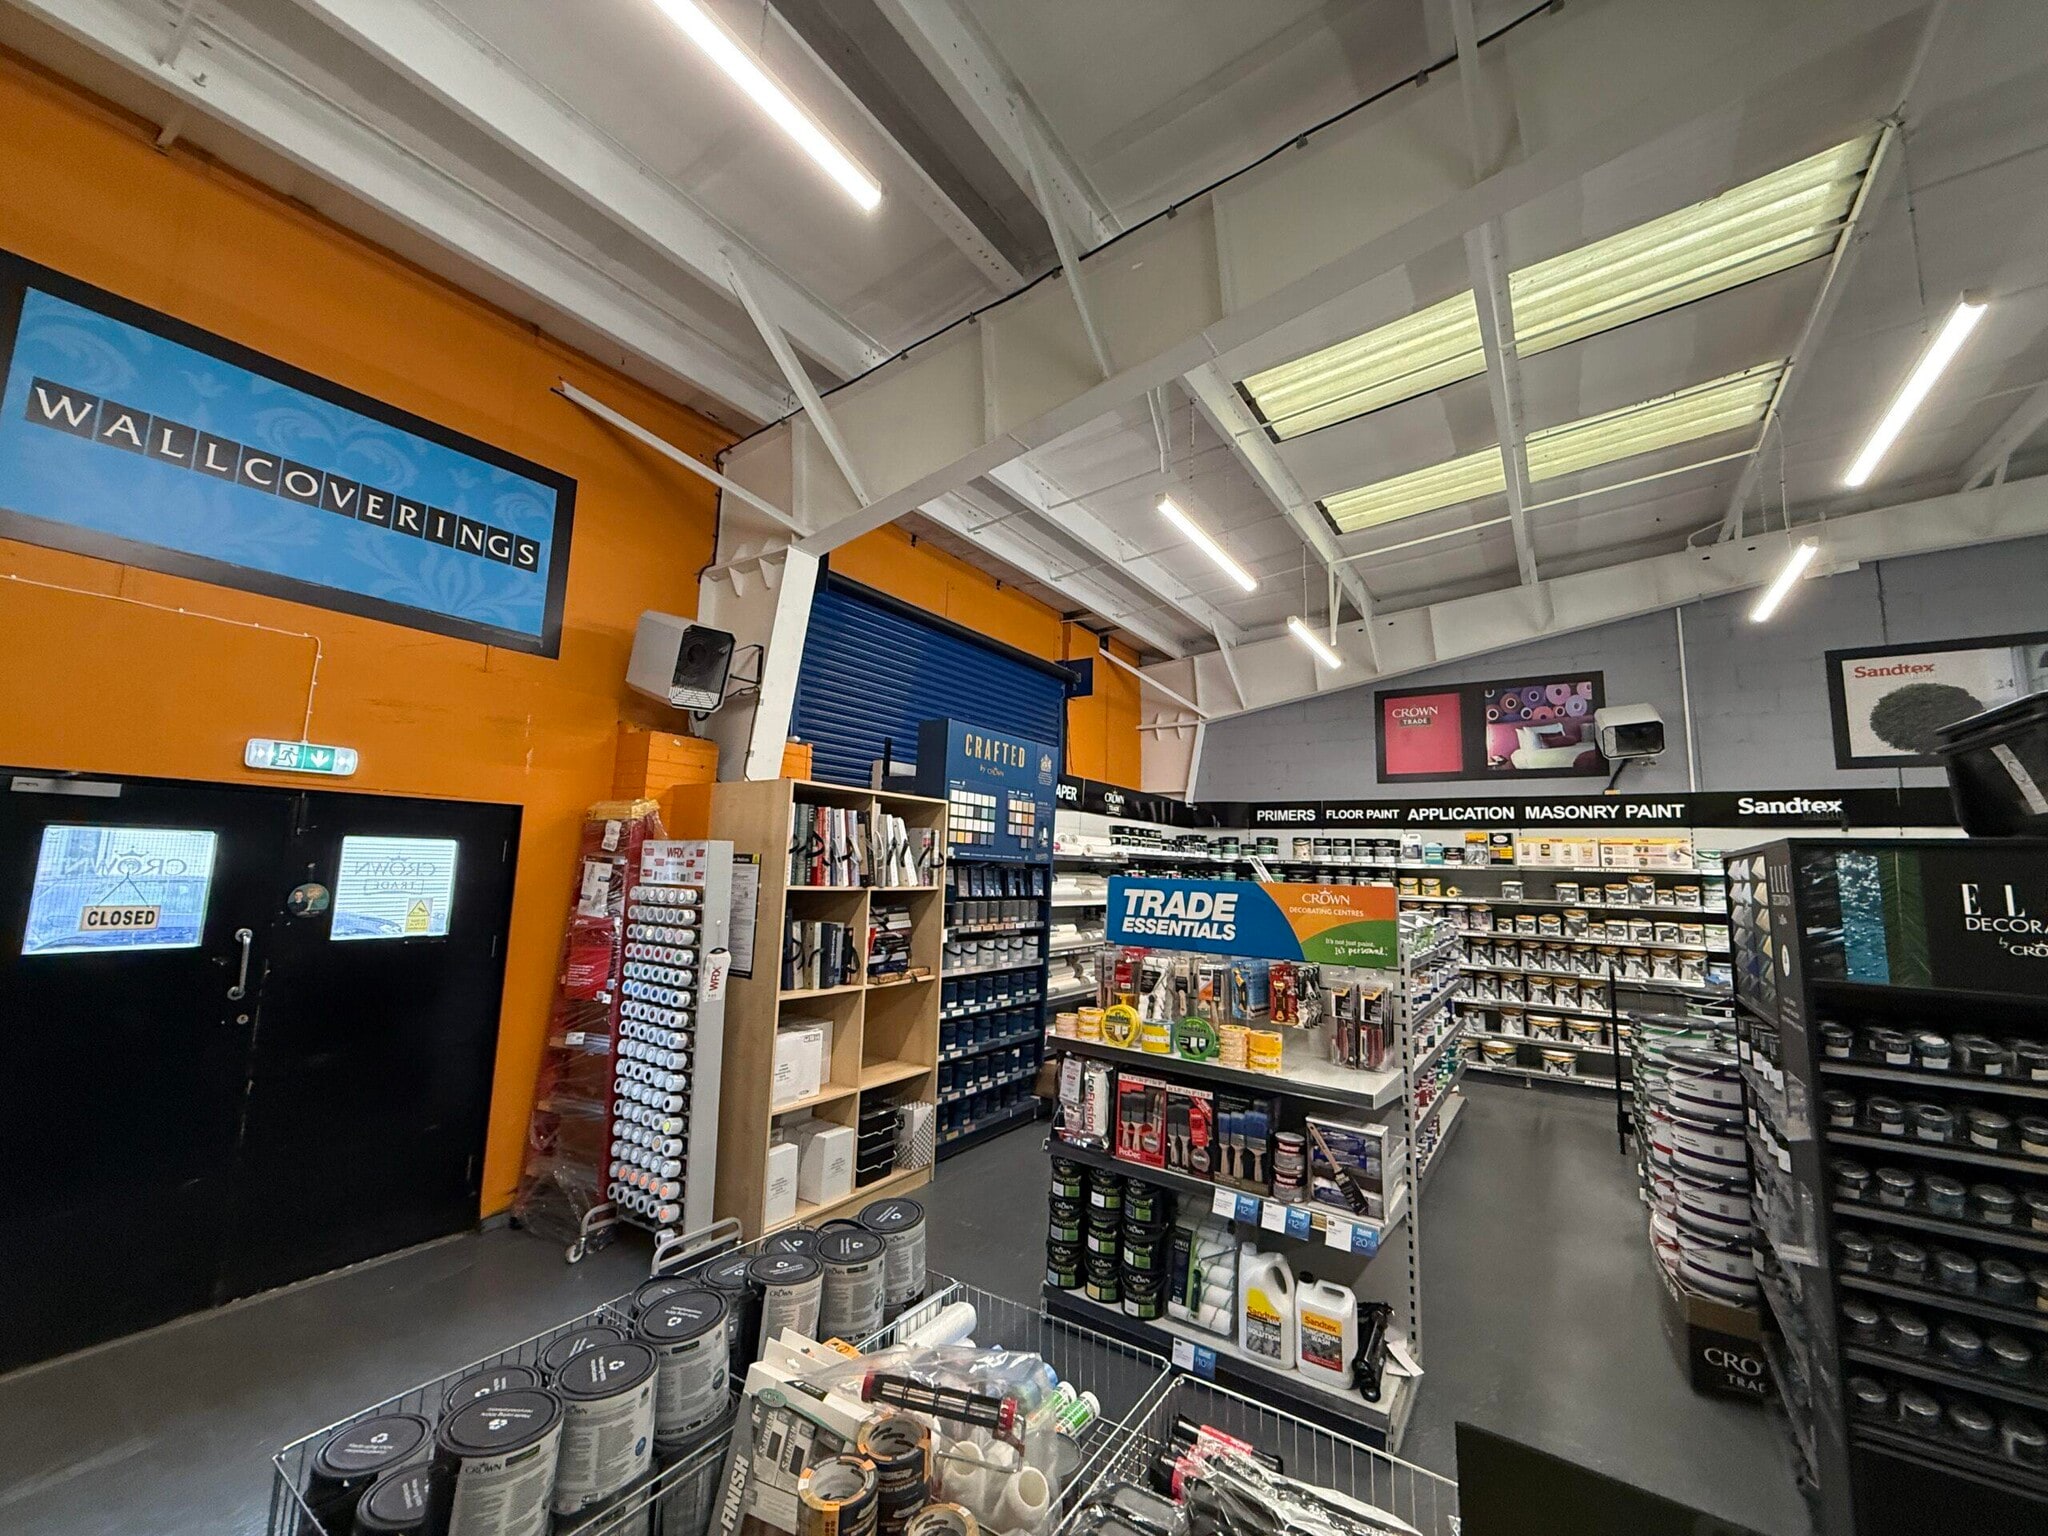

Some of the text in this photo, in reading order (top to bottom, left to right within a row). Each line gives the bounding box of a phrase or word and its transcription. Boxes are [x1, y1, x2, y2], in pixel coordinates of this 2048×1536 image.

[36, 386, 535, 566] WALLCOVERINGS
[1854, 663, 1935, 679] Sandtex
[1392, 706, 1438, 718] CROWN
[1403, 717, 1427, 725] TRADE
[965, 733, 1025, 768] CRAFTED
[1104, 792, 1125, 805] CROWN
[1738, 797, 1843, 815] Sandtex
[1257, 809, 1316, 821] PRIMERS
[1326, 808, 1400, 820] FLOOR PAINT
[1407, 806, 1515, 821] APPLICATION
[1525, 804, 1685, 820] MASONRY PAINT
[1124, 888, 1238, 922] TRADE
[1302, 892, 1350, 906] CROWN
[87, 910, 155, 926] CLOSED
[1289, 906, 1364, 918] DECORATING CENTRES
[1122, 917, 1236, 941] ESSENTIALS
[709, 966, 722, 991] WRX
[1119, 1149, 1141, 1159] ProDec
[770, 1289, 793, 1297] CROWN
[1248, 1306, 1281, 1321] Sandtex
[1304, 1315, 1337, 1333] Sandtex
[1311, 1335, 1330, 1347] WASH
[465, 1463, 501, 1475] CROWN
